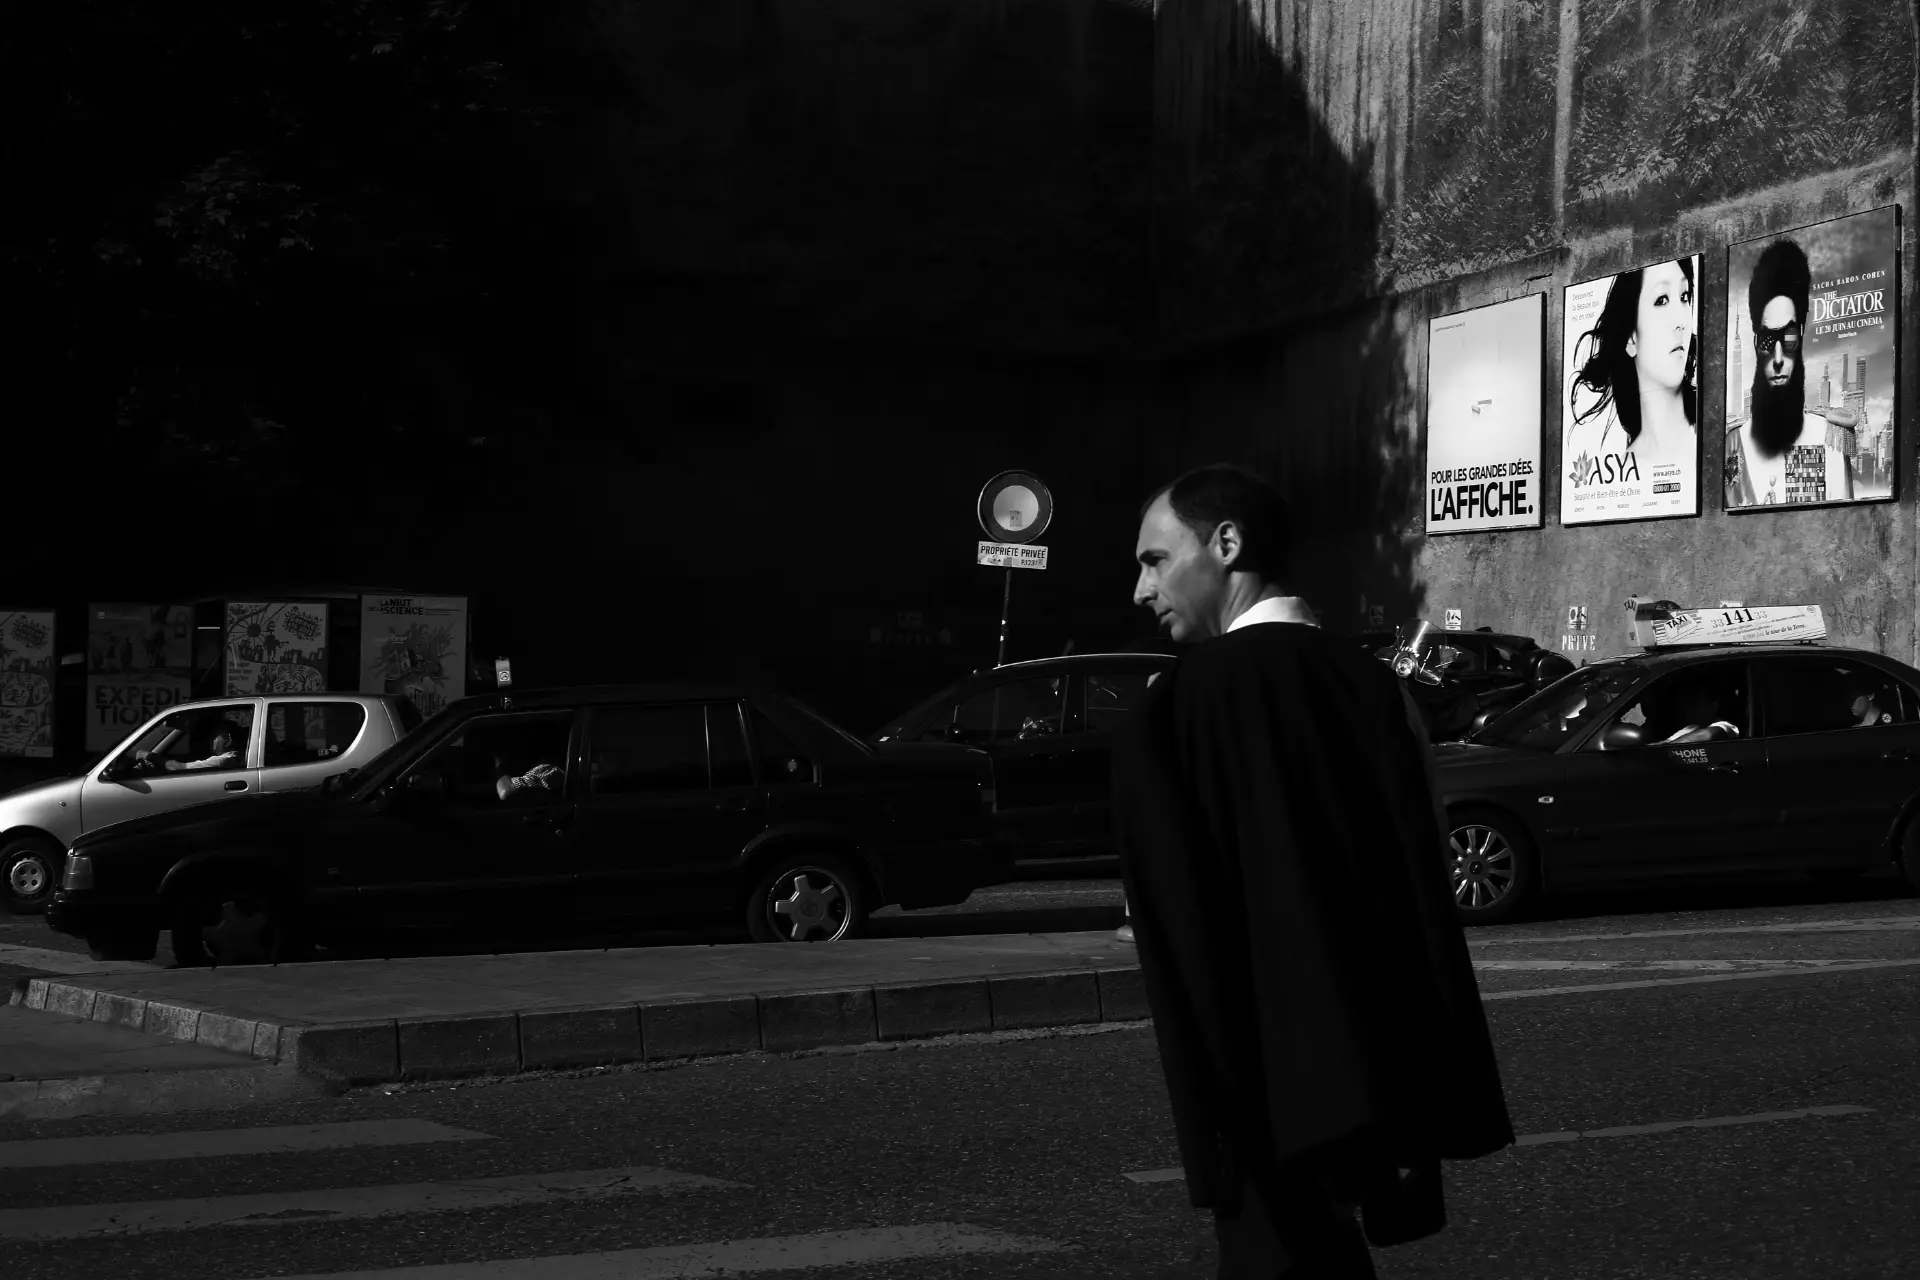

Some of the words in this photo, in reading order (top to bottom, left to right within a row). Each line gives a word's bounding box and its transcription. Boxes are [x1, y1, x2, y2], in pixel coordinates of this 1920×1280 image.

[1812, 281, 1834, 290] SACHA
[1836, 275, 1859, 286] BARON
[1861, 270, 1886, 281] COHEN
[1823, 291, 1838, 301] THE
[1812, 291, 1885, 322] DICTATOR
[1815, 326, 1825, 335] LE
[1832, 322, 1846, 333] JUIN
[1846, 320, 1856, 330] AU
[1431, 470, 1452, 484] POUR
[1453, 468, 1467, 482] LES
[1468, 463, 1507, 481] GRANDES
[1508, 458, 1534, 476] IDÉES.
[1588, 451, 1640, 486] ASYA
[1431, 479, 1534, 521] L'AFFICHE.
[980, 545, 1019, 557] PROPRIÉTÉ
[1021, 548, 1046, 559] PRIVÉE
[384, 606, 424, 616] SCIENCE
[1722, 608, 1755, 626] 141
[1666, 614, 1688, 629] TAXI
